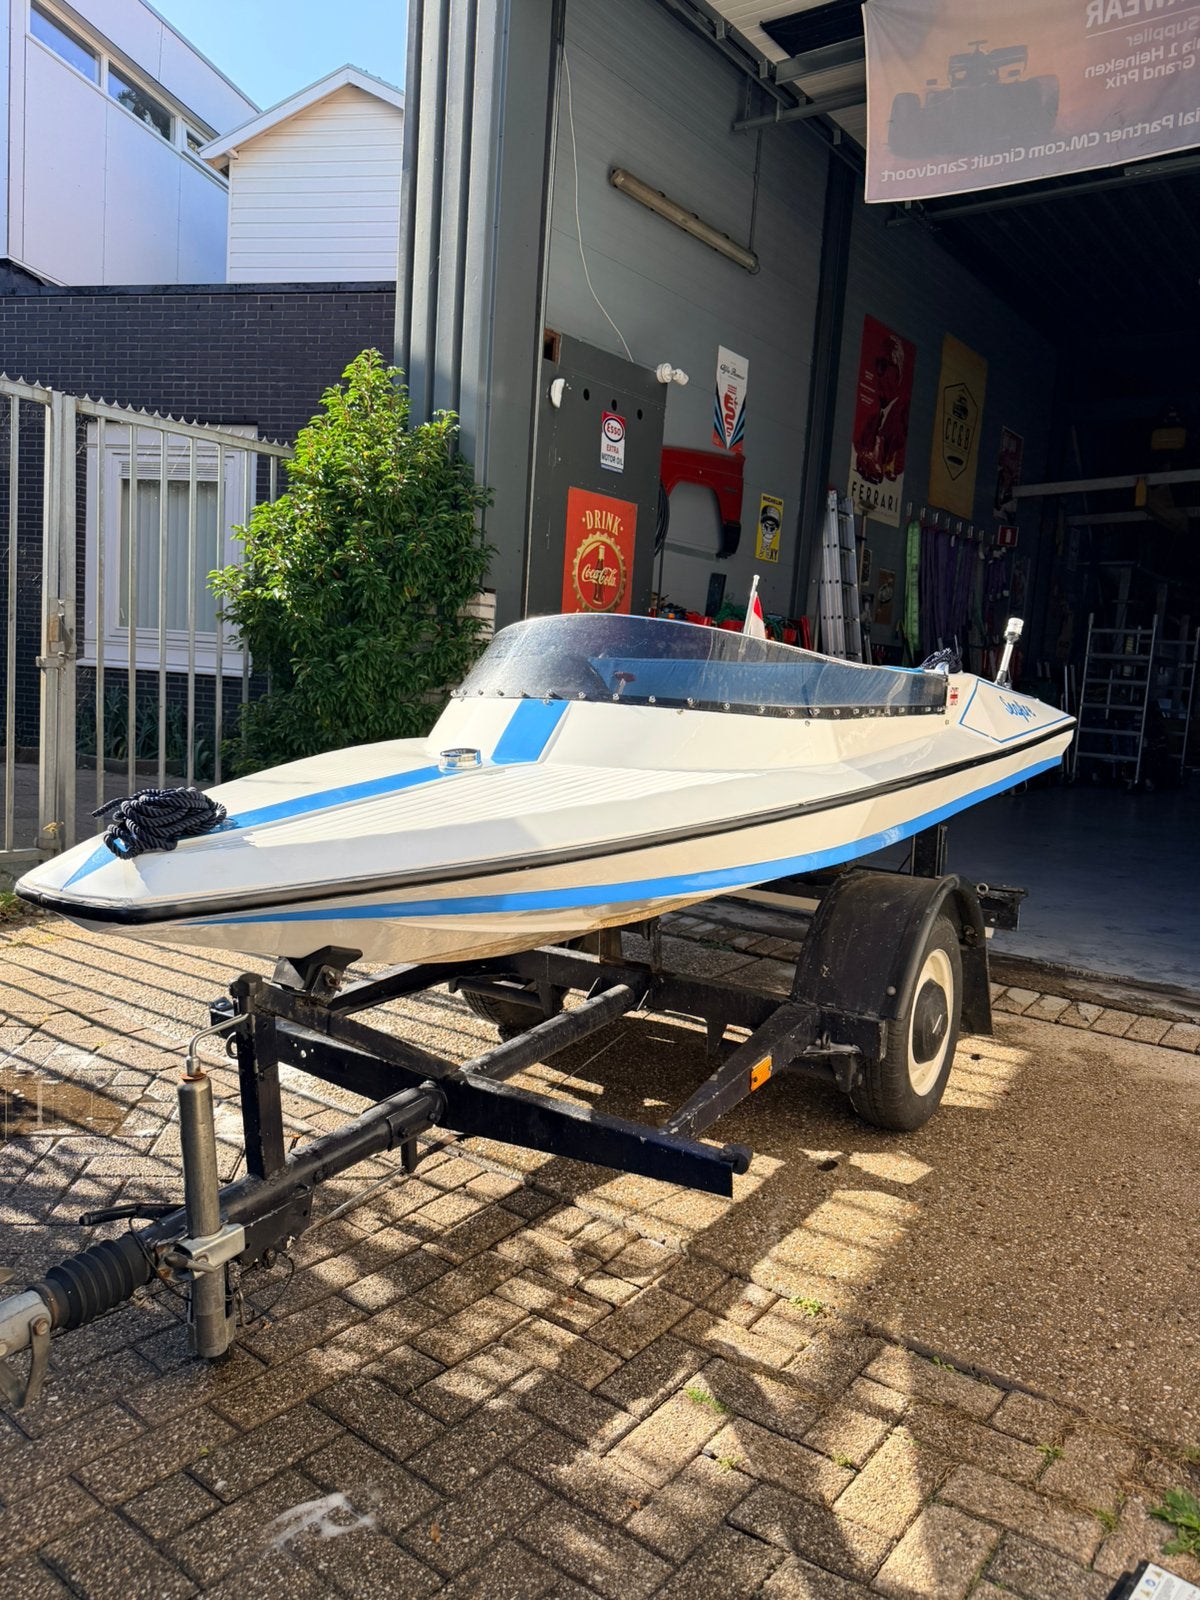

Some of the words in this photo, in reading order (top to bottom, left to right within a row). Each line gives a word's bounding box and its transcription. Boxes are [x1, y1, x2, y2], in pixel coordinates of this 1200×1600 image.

[606, 443, 619, 454] EXTRA
[851, 481, 898, 512] FERRARI
[585, 509, 622, 536] DRINK
